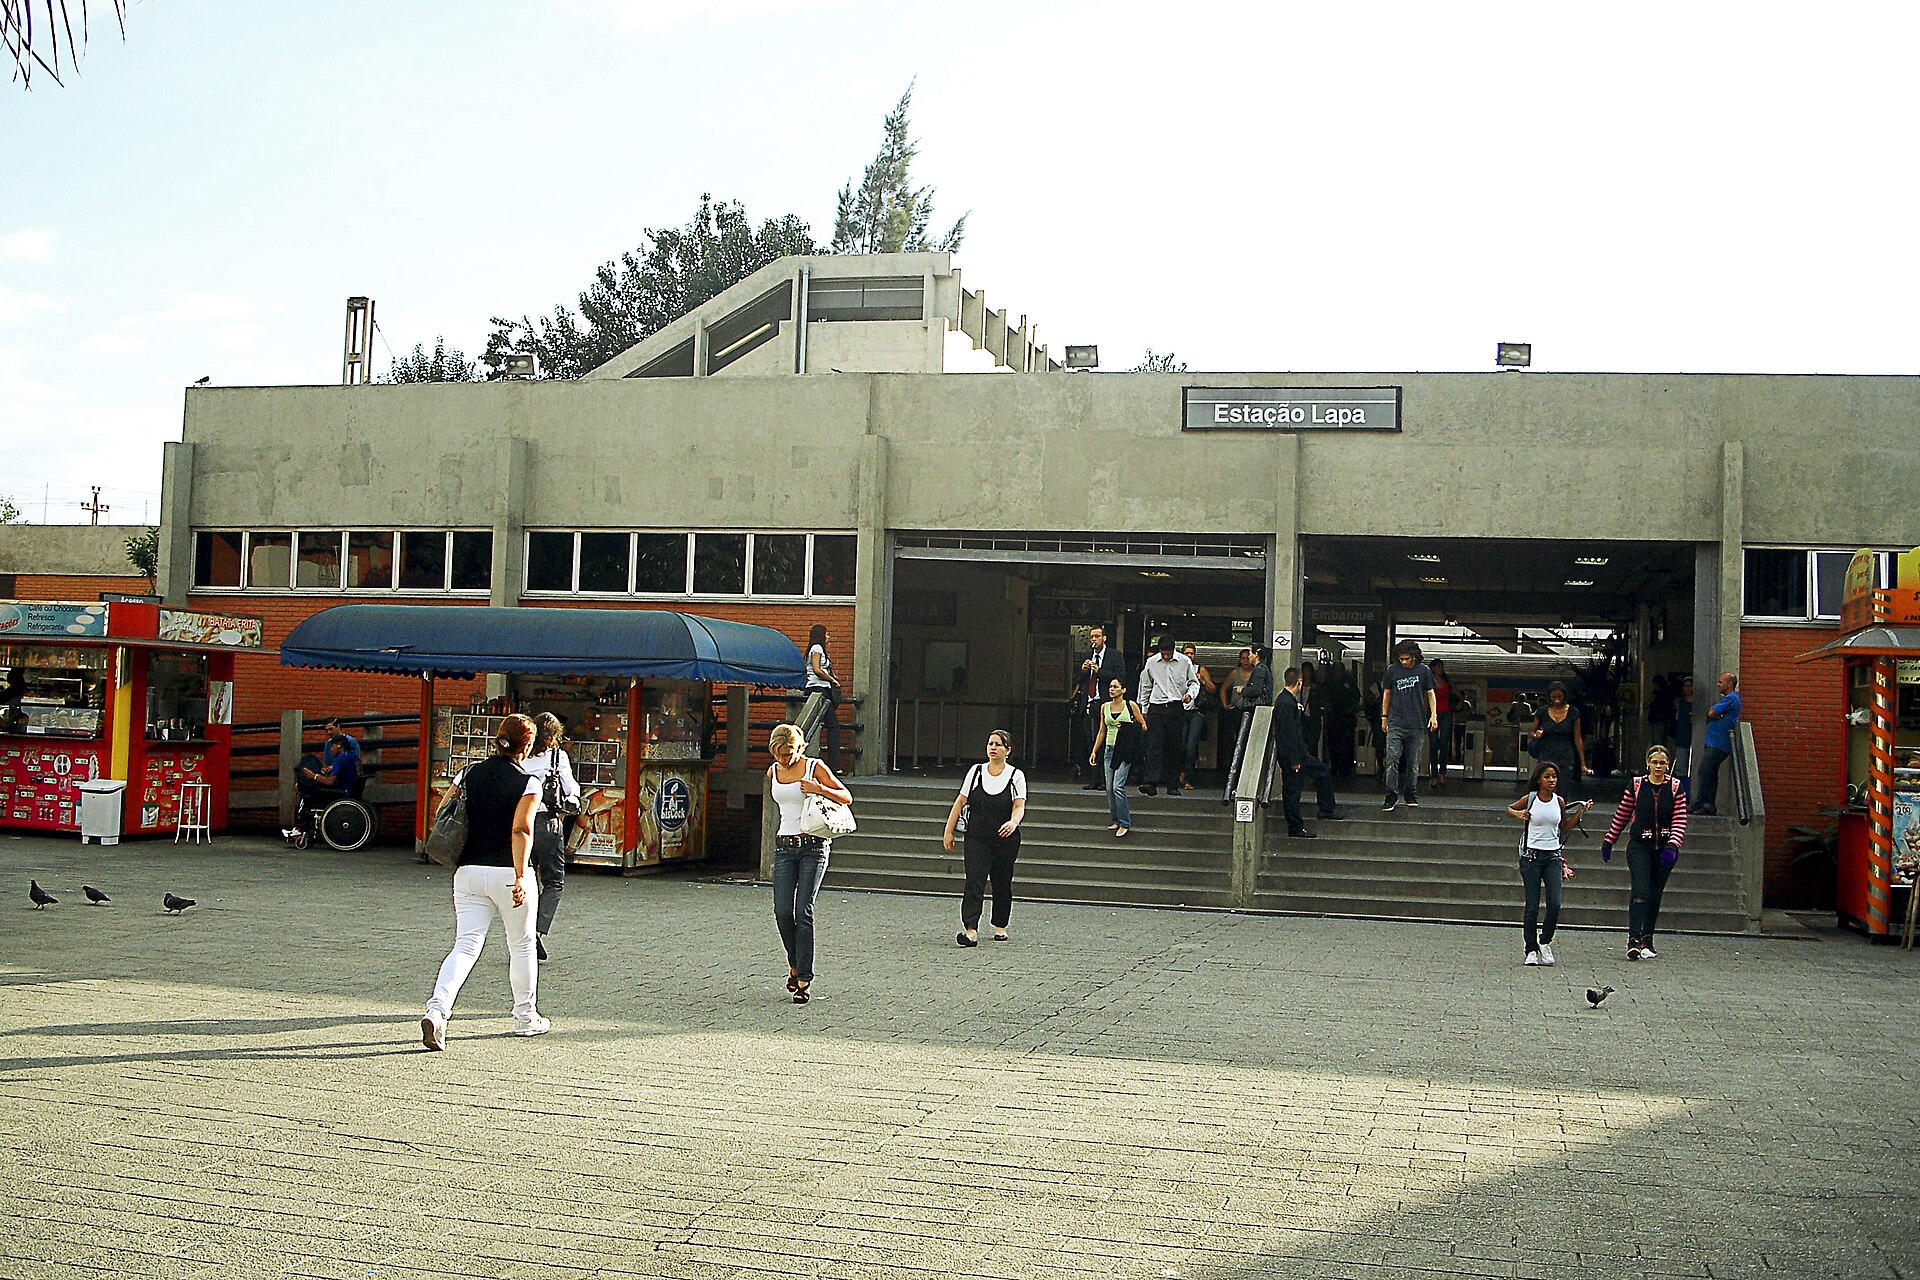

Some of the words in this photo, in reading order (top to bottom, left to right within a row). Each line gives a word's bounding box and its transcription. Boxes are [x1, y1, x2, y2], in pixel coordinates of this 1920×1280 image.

[1214, 403, 1305, 427] Estação
[1312, 404, 1365, 427] Lapa
[27, 612, 55, 621] Refresco
[209, 616, 236, 628] BATATA
[237, 618, 257, 630] FRITA
[1310, 608, 1375, 624] Embarque
[27, 622, 65, 632] Refrigerante
